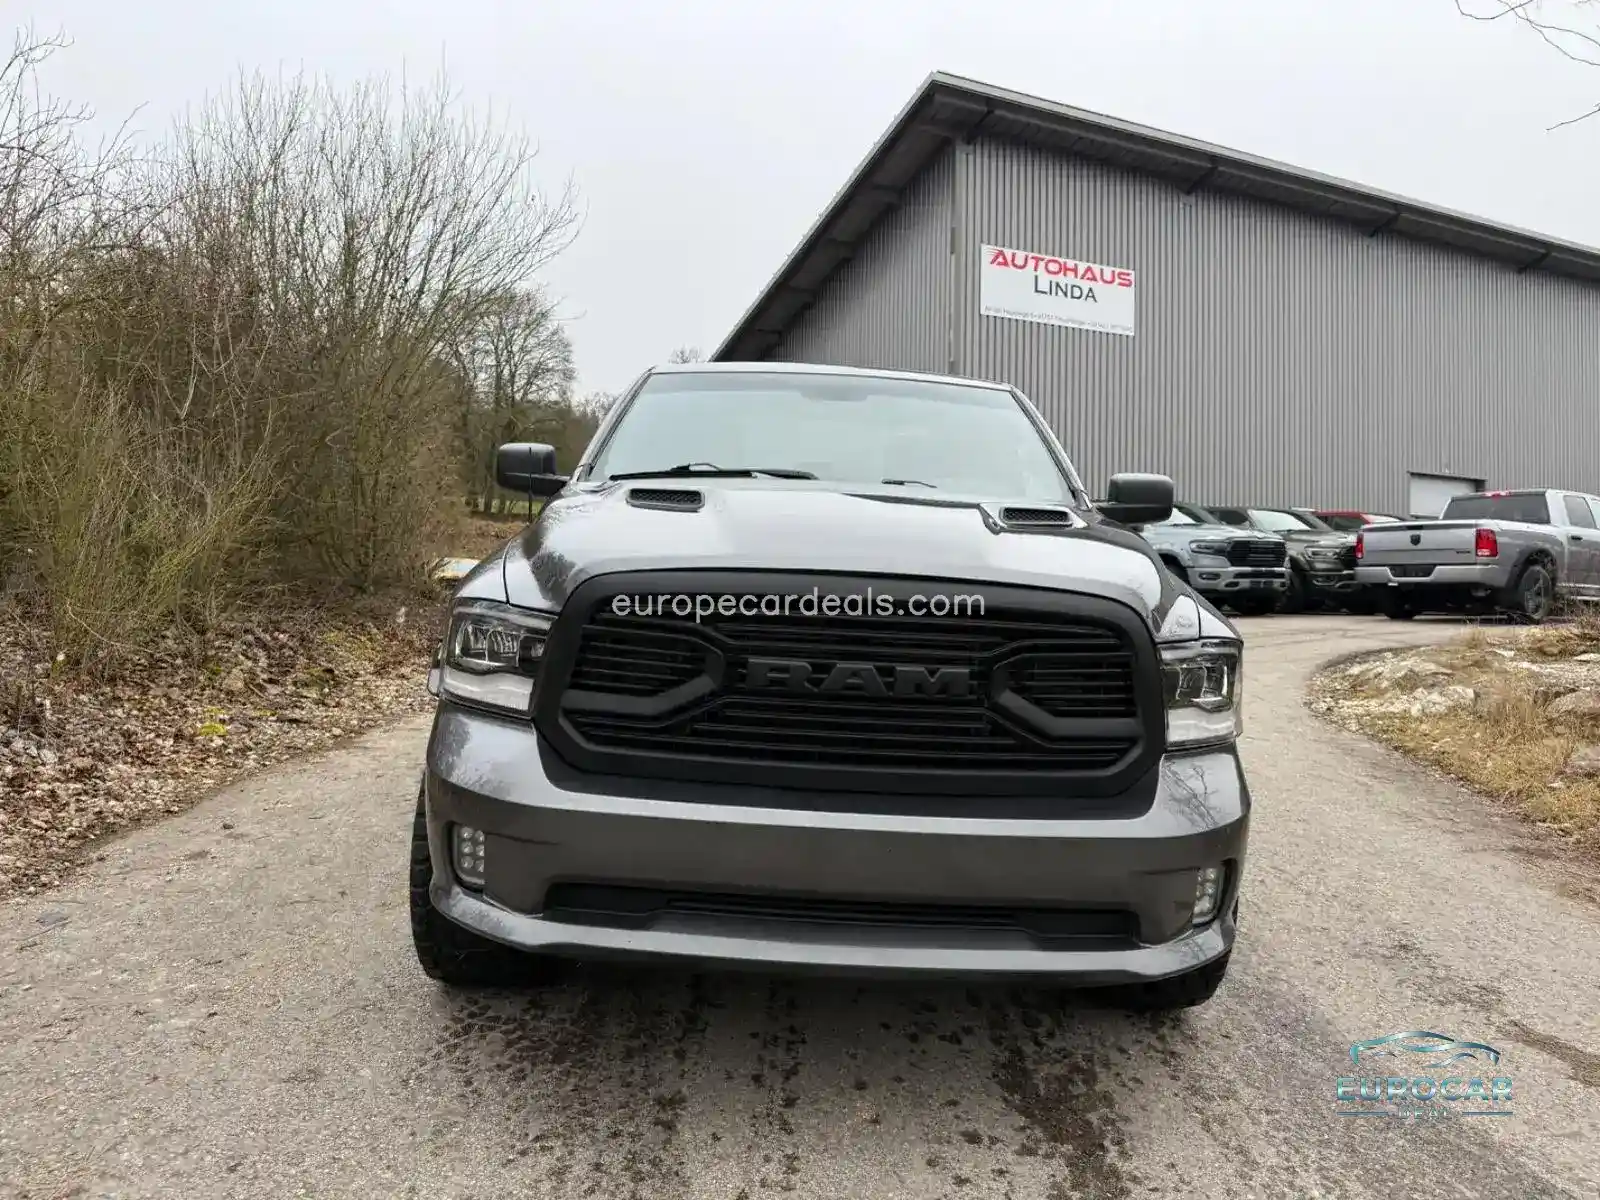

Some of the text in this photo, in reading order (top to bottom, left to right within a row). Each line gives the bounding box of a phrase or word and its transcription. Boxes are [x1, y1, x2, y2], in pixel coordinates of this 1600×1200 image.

[988, 249, 1133, 288] AUTOHAUS
[1034, 274, 1098, 303] LINDA
[746, 658, 970, 696] RAM
